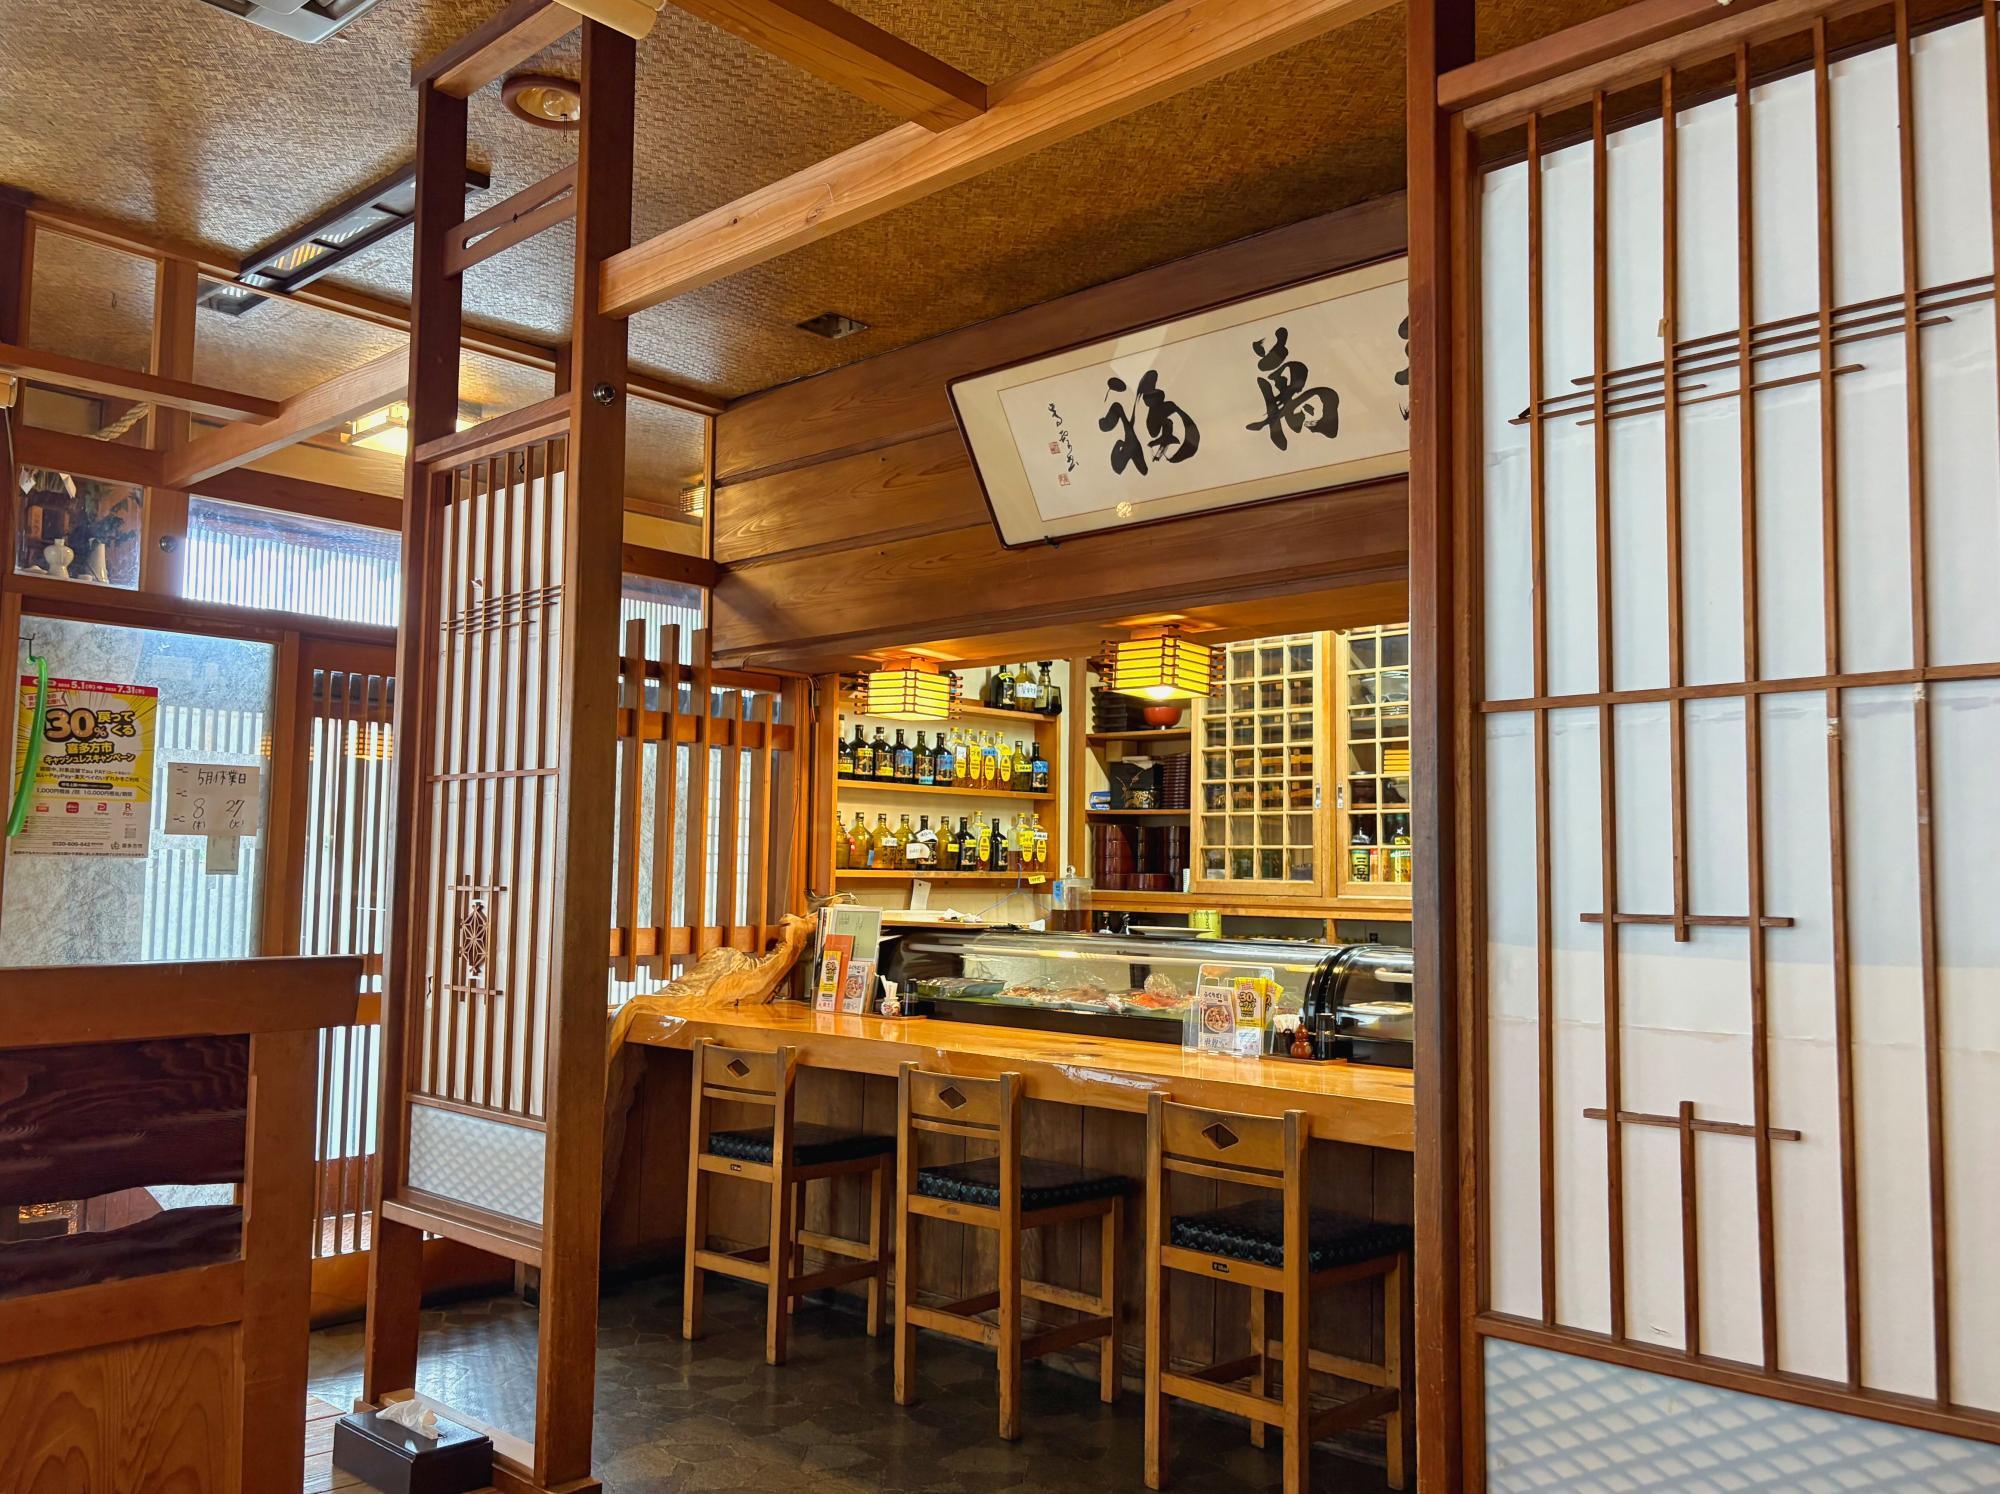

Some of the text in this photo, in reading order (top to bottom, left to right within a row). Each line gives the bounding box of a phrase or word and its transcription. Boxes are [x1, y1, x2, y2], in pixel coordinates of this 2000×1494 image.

[97, 710, 135, 723] 戻って
[45, 708, 108, 741] 30%
[111, 724, 136, 737] くる
[65, 742, 115, 755] 喜多方市
[44, 753, 136, 765] キャッシュレスキャンペーン
[197, 767, 247, 786] 5月休業日
[192, 797, 246, 819] 8 27
